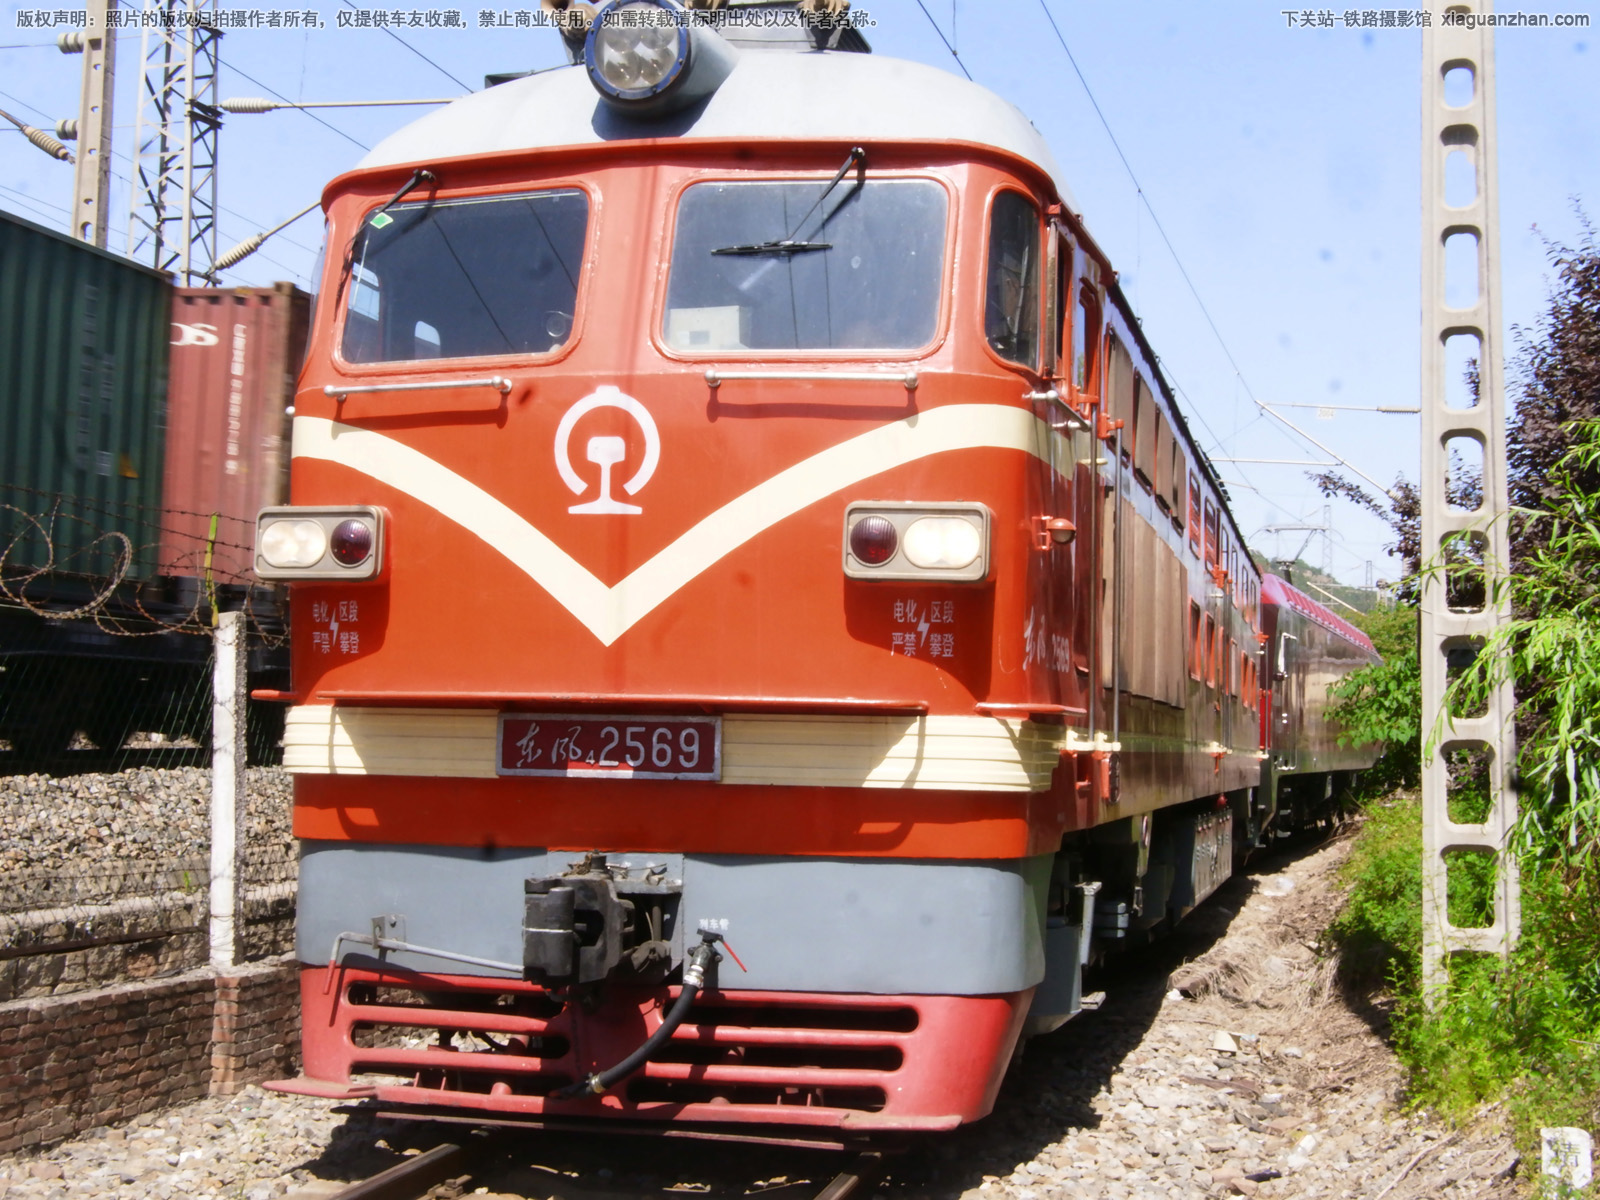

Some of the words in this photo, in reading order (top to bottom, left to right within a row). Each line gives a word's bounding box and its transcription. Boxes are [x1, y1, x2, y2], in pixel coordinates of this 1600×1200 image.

[312, 599, 330, 623] 电化
[339, 599, 359, 623] 区段
[893, 598, 918, 624] 电化
[931, 600, 955, 624] 区段
[312, 631, 331, 655] 严禁
[890, 631, 917, 657] 严禁
[929, 632, 955, 658] 攀登
